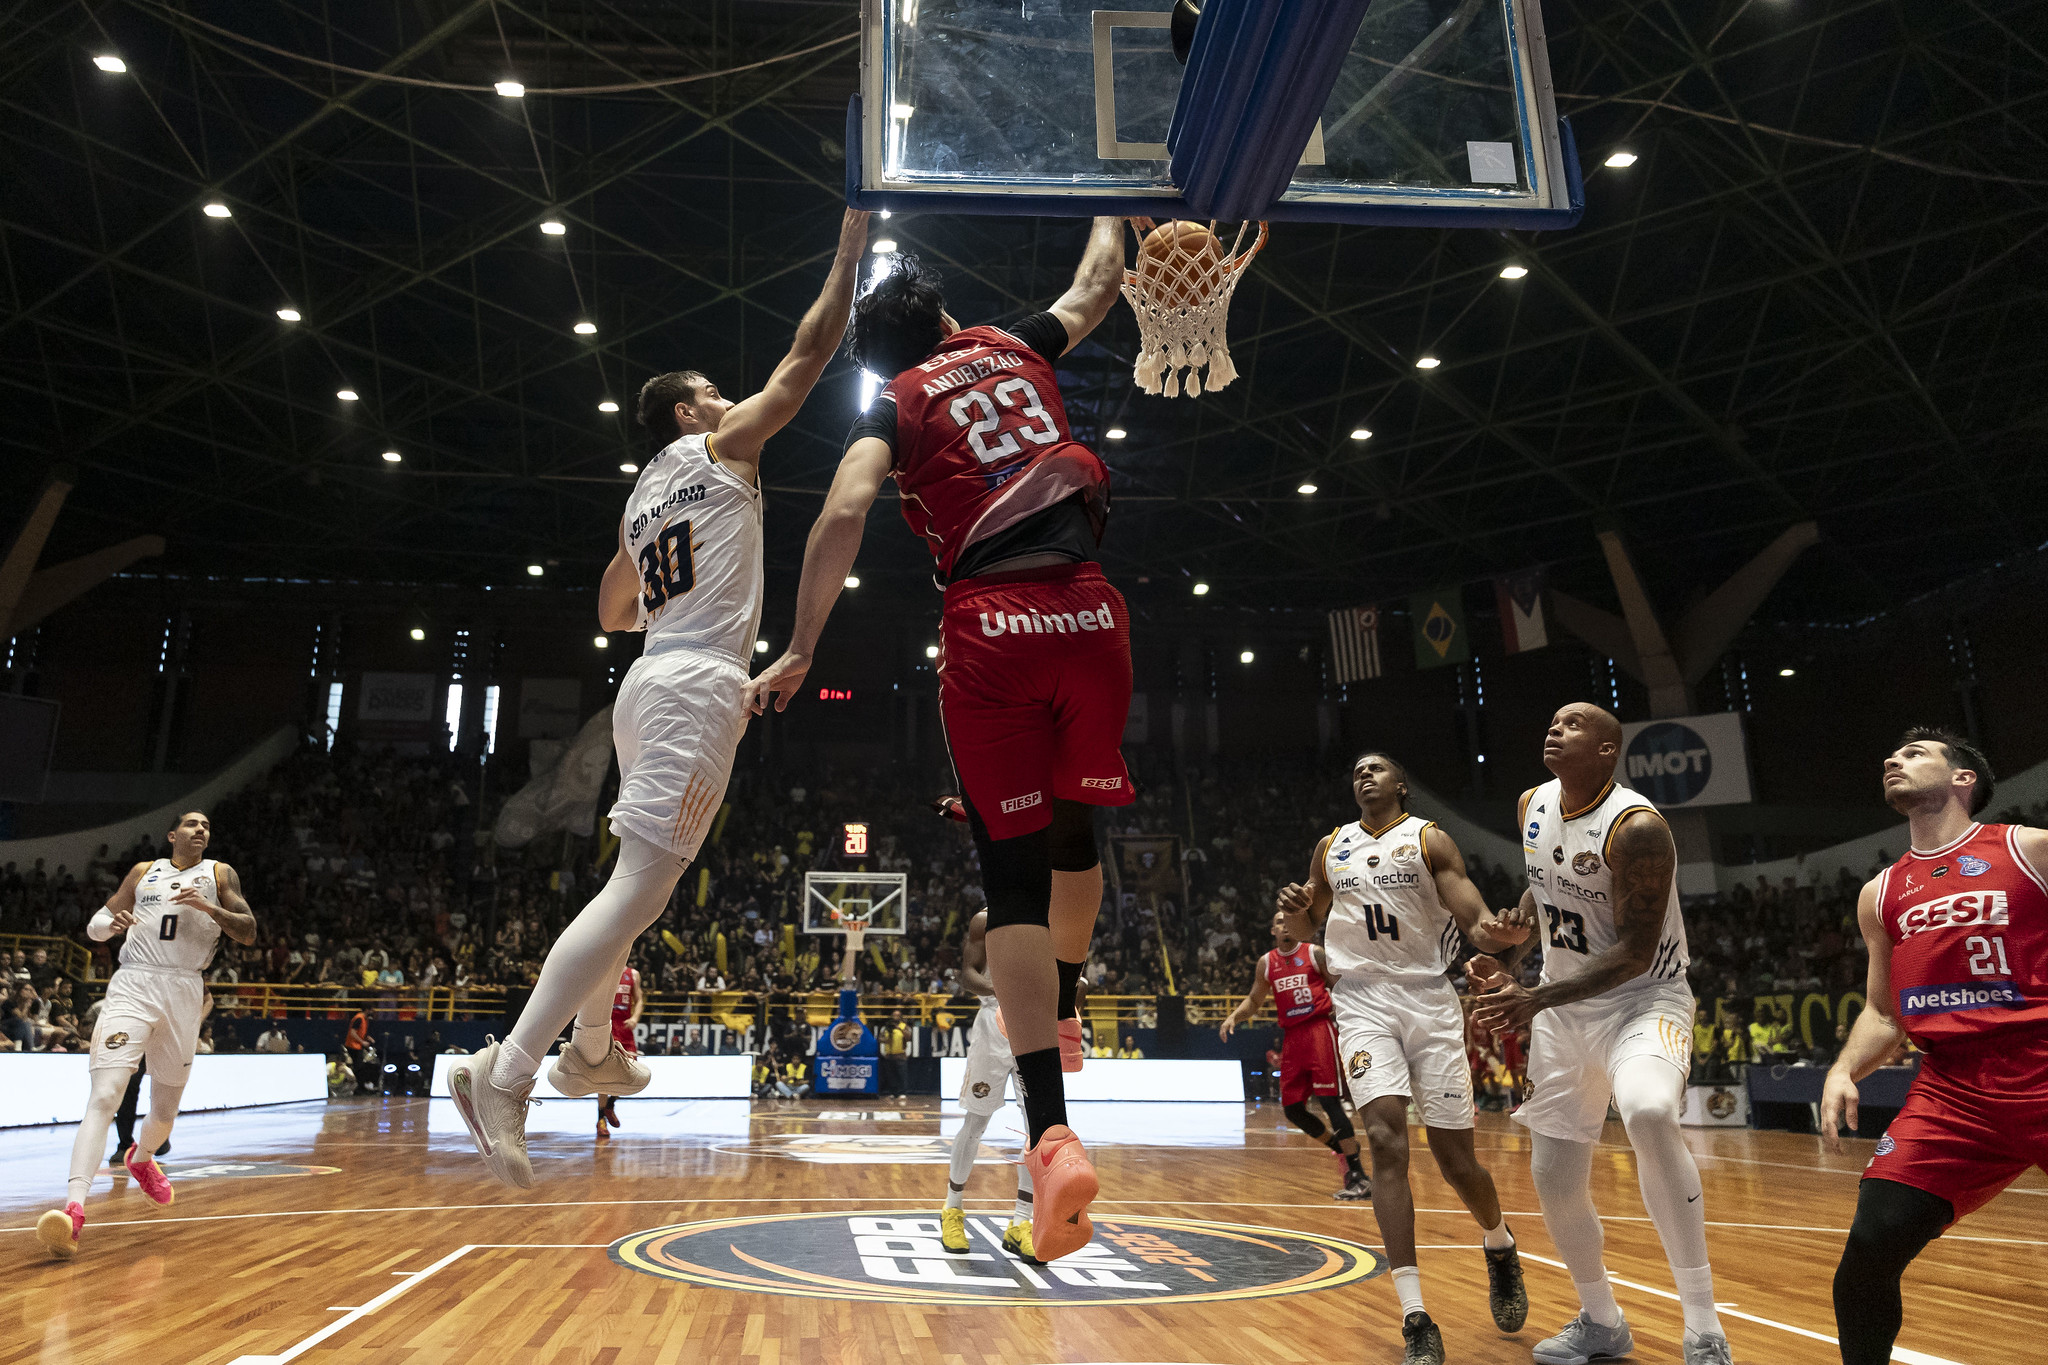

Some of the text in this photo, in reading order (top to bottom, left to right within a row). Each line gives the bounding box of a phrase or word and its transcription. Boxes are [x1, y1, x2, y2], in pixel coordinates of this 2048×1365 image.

[922, 350, 1024, 398] ANDREZÃO
[949, 376, 1060, 465] 23
[638, 519, 695, 613] 30
[979, 602, 1115, 638] Unimed
[1628, 748, 1708, 778] IMOT
[1085, 776, 1120, 789] SESI
[1004, 794, 1040, 812] FIESP
[1341, 871, 1419, 889] HIC necton
[1527, 864, 1544, 880] HIC
[159, 914, 178, 941] 0
[1362, 903, 1400, 941] 14
[1542, 903, 1589, 955] 23
[1905, 894, 1994, 935] SESI
[1965, 935, 2012, 976] 21
[1279, 976, 1304, 990] SESI
[1293, 987, 1313, 1005] 29
[848, 1217, 1021, 1288] FPB
